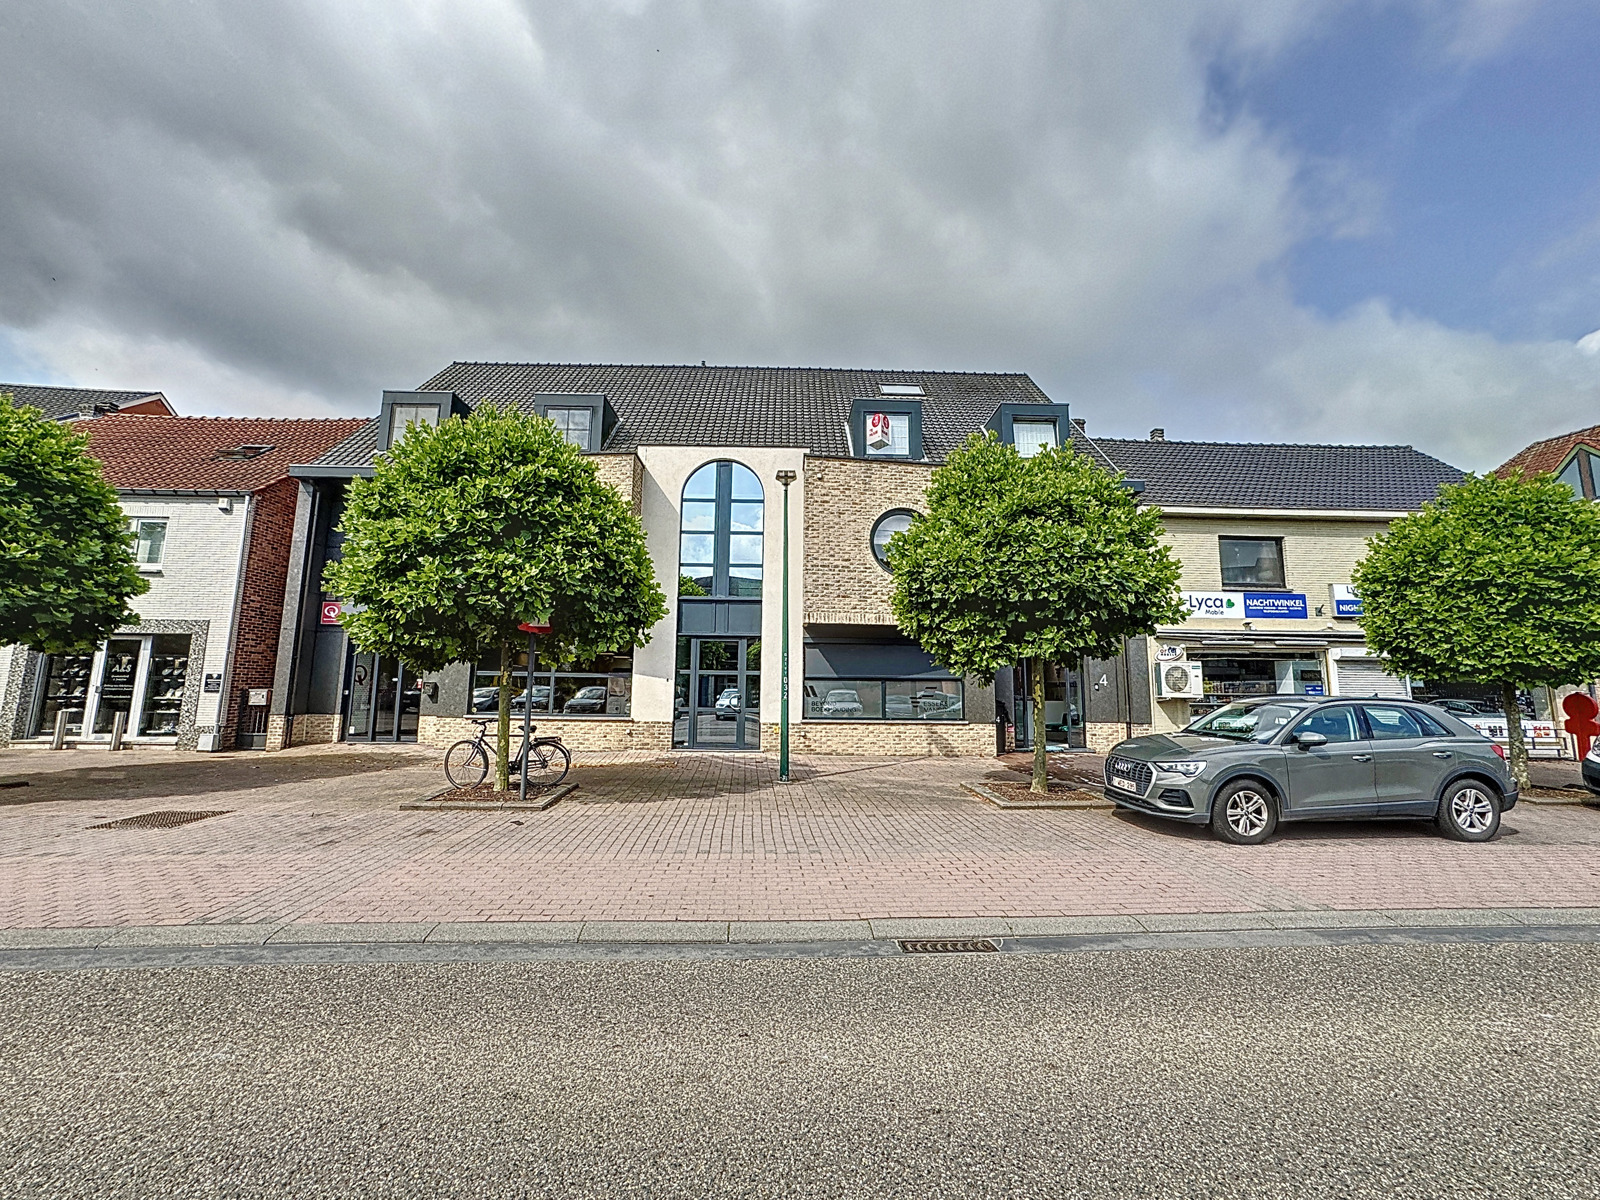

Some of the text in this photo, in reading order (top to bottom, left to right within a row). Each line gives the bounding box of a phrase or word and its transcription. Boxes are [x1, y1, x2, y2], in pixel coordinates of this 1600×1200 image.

[1189, 594, 1224, 611] Lyca
[1246, 599, 1305, 607] NACHTWINKEL
[324, 605, 339, 618] Q
[1099, 673, 1108, 687] 4
